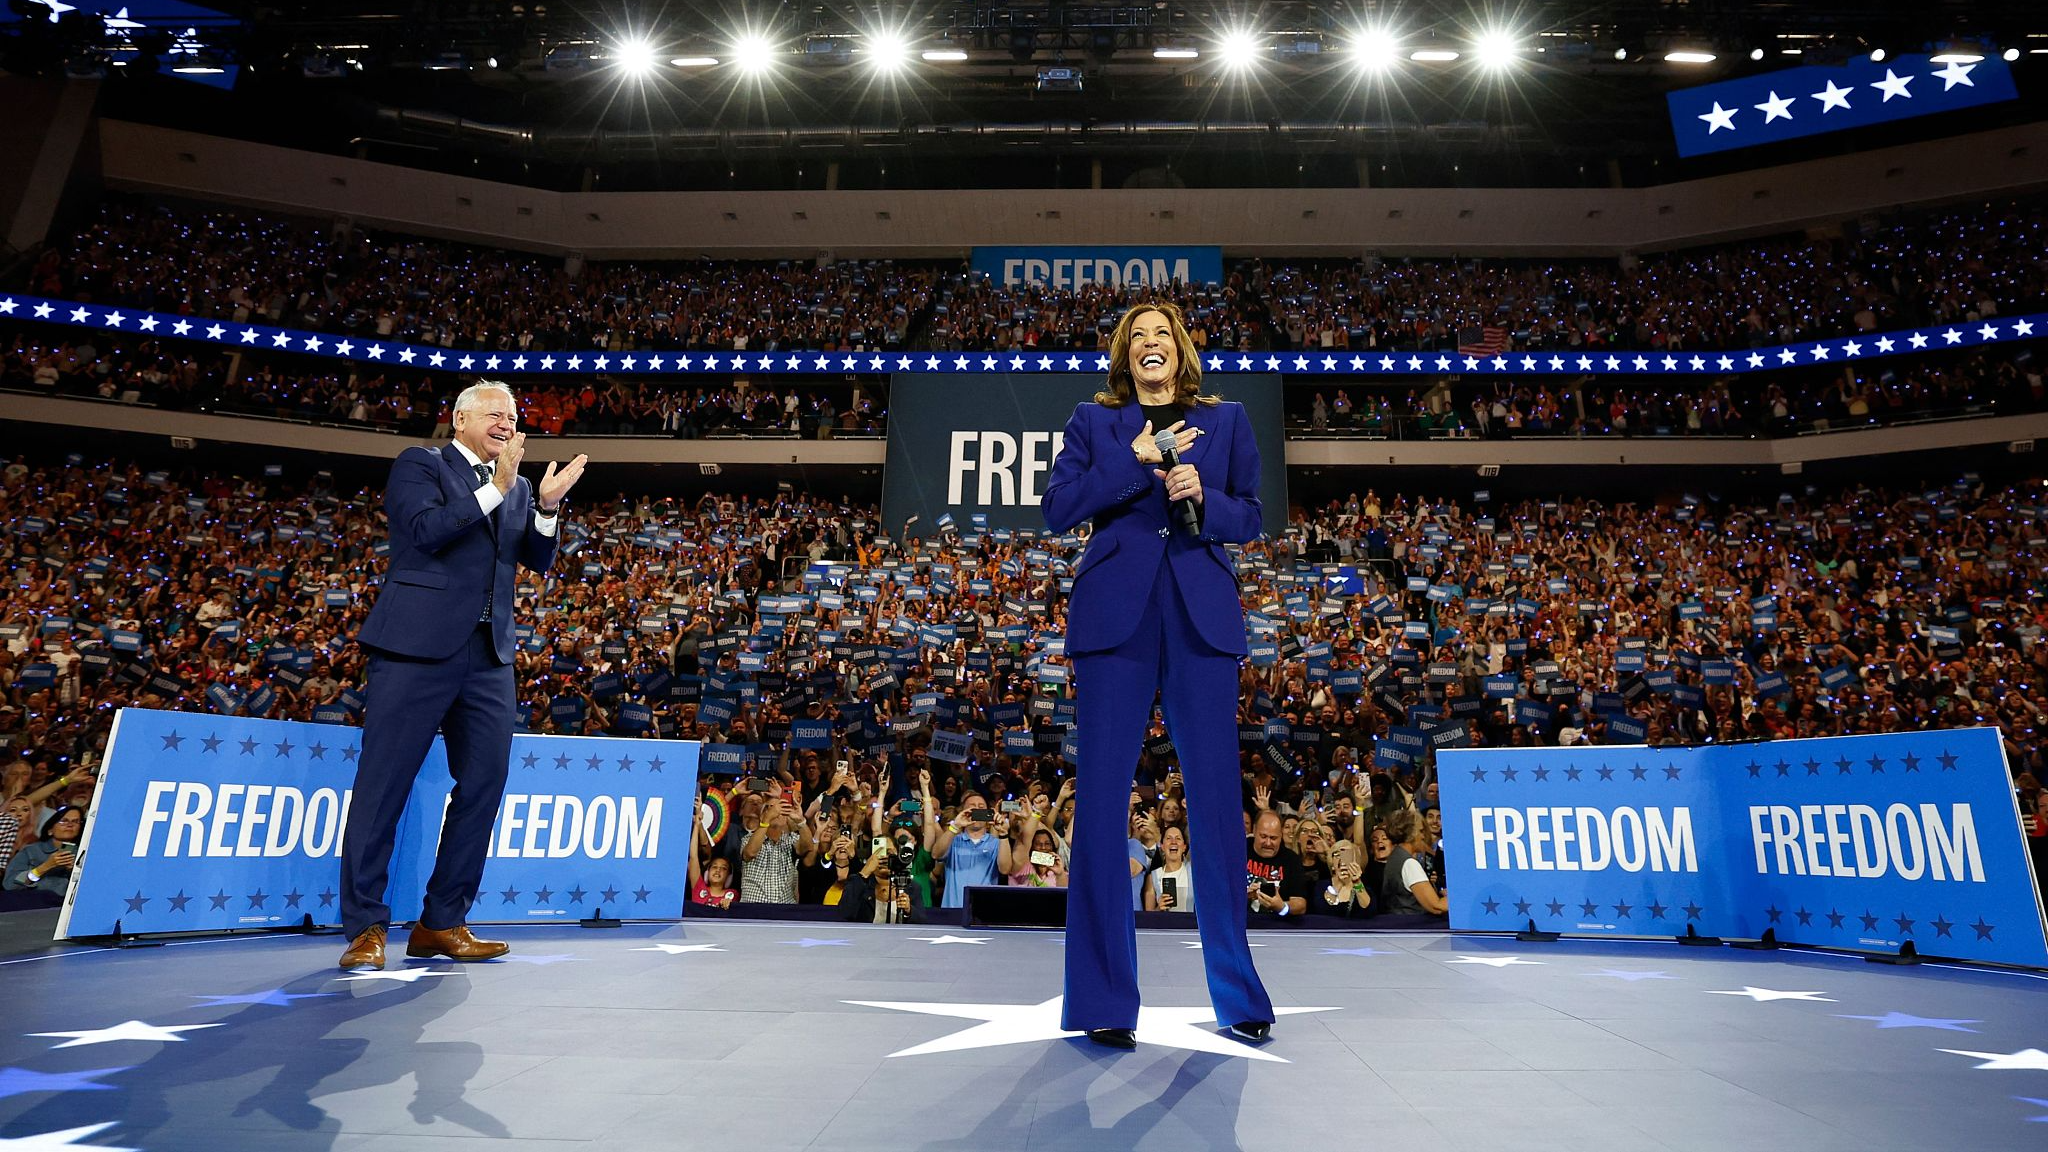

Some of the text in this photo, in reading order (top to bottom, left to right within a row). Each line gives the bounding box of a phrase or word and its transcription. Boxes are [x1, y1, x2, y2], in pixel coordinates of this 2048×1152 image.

[1004, 258, 1190, 295] FREEDOM
[702, 466, 716, 474] 116
[947, 431, 1064, 506] FRE
[1484, 467, 1498, 476] 118
[1383, 615, 1403, 623] FREEDOM
[834, 647, 851, 655] FREEDO
[853, 649, 875, 660] FREEDOM
[1252, 647, 1275, 656] FREEDOM
[1618, 656, 1642, 664] FREEDOM
[1368, 663, 1388, 683] FREEDOM
[1430, 667, 1456, 676] FREEDOM
[1535, 665, 1559, 674] FREEDOM
[870, 675, 894, 690] FREEDOM
[1334, 677, 1358, 686] FREEDOM
[1488, 682, 1515, 690] FREEDOM
[671, 686, 697, 696] FREEDOM
[915, 697, 937, 707] FREEDO
[1034, 700, 1055, 710] FREEDO
[623, 709, 650, 722] FREEDOM
[704, 704, 731, 720] FREEDOM
[892, 720, 921, 731] FREEDOM
[1612, 720, 1644, 737] FREEDOM
[796, 728, 827, 739] FREEDOM
[1432, 727, 1465, 745] FREEDOM
[1393, 733, 1423, 747] FREEDOM
[934, 740, 946, 752] WE
[708, 752, 740, 763] FREEDOM
[1267, 744, 1293, 774] FREEDOM
[1380, 747, 1410, 764] FREEDOM
[131, 780, 353, 858] FREEDO
[436, 793, 664, 859] EEDOM
[1471, 807, 1698, 873] FREEDOM
[1749, 803, 1986, 882] FREEDOM
